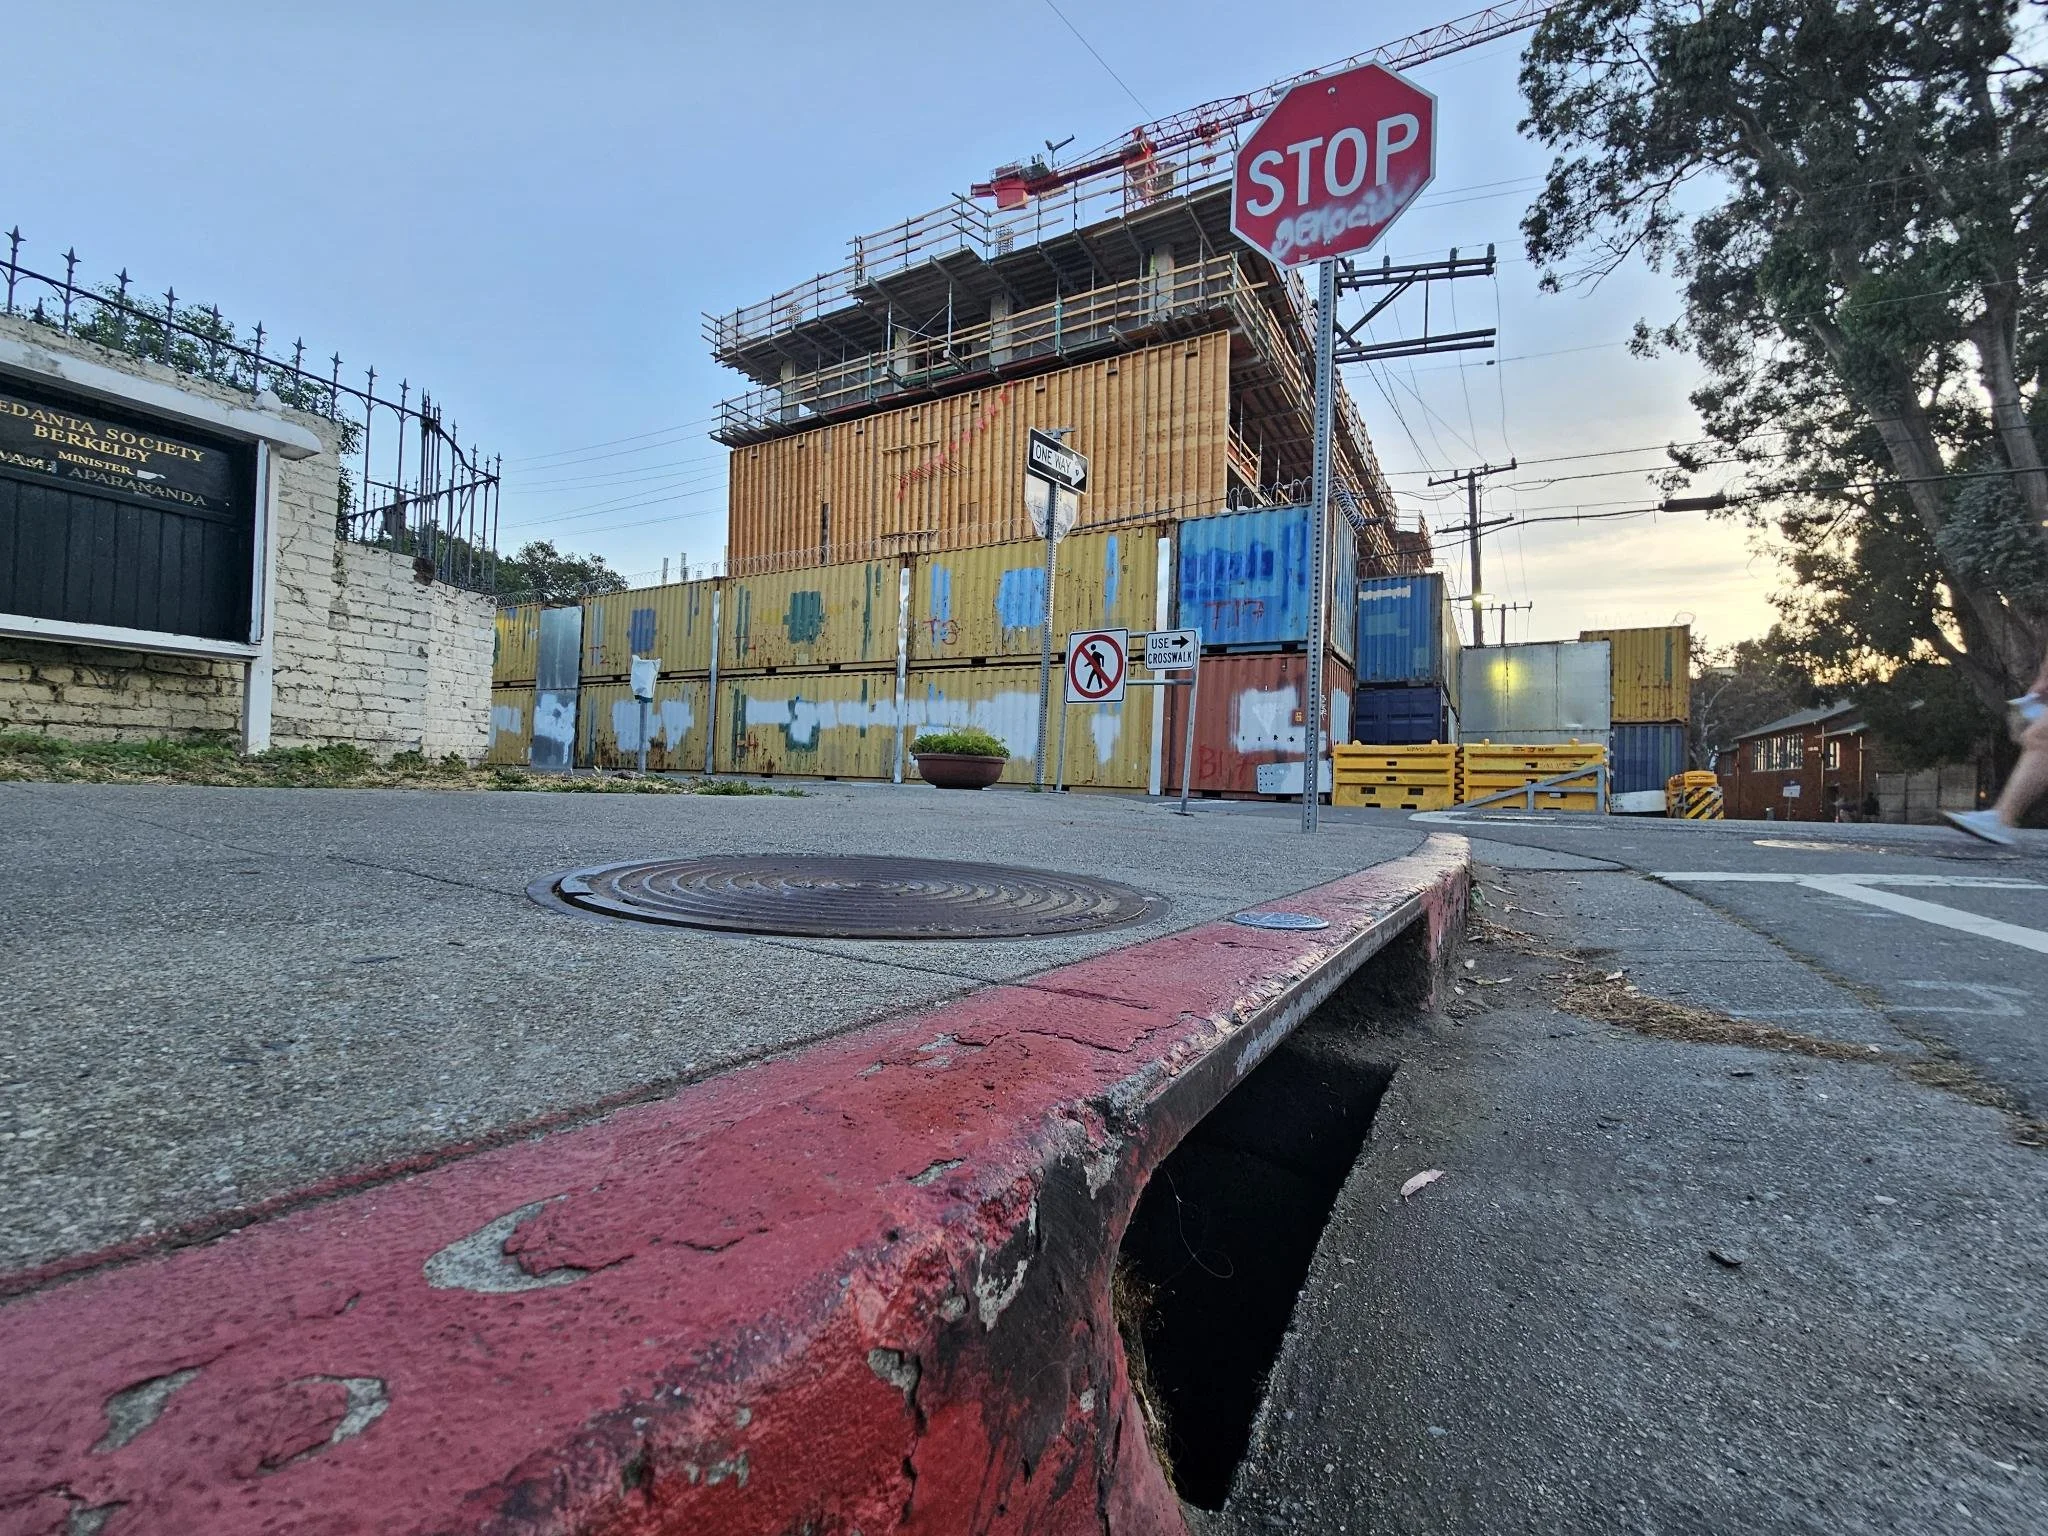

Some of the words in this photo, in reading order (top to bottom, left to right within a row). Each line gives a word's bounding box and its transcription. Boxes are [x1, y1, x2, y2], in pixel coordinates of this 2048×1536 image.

[1246, 113, 1420, 217] STOP
[0, 400, 97, 436] EDANTA
[106, 428, 204, 462] SOCIETY
[33, 424, 150, 463] BERKELEY
[58, 451, 135, 475] MINISTER
[1036, 444, 1053, 466] ONE
[1055, 453, 1072, 474] WAY
[68, 467, 208, 506] APARANANDA
[1148, 651, 1192, 664] CROSSWALK
[1152, 637, 1169, 649] USE
